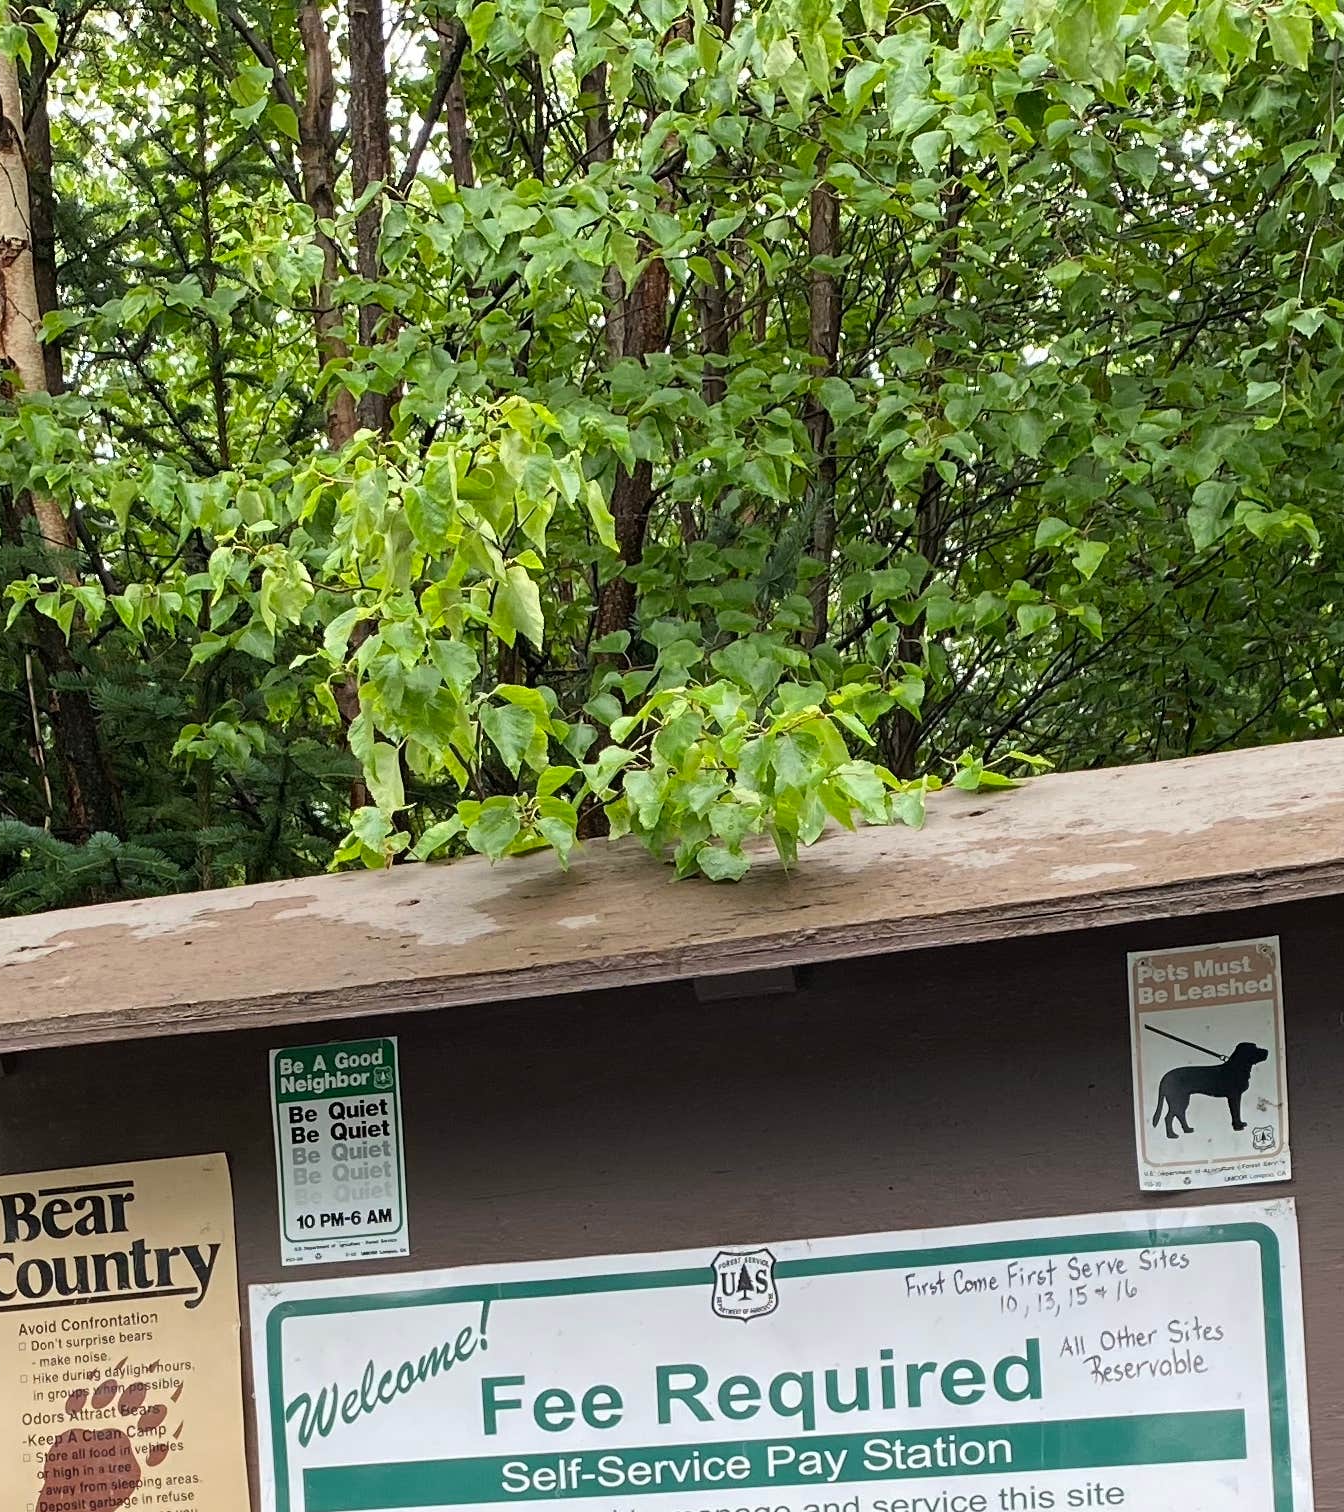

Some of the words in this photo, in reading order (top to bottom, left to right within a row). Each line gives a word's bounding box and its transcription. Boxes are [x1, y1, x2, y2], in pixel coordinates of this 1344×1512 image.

[1138, 964, 1189, 984] Pets
[1193, 955, 1252, 978] Must
[1138, 986, 1169, 1005] Be
[1173, 973, 1274, 1000] Leashed
[279, 1058, 304, 1075] Be
[313, 1055, 326, 1072] A
[334, 1048, 384, 1069] Good
[280, 1071, 371, 1094] Neighbor
[288, 1105, 317, 1124] Be
[328, 1099, 388, 1120] Quiet
[291, 1126, 320, 1144] Be
[330, 1120, 390, 1141] Quiet
[292, 1147, 321, 1165] Be
[331, 1140, 392, 1161] Quiet
[293, 1168, 322, 1185] Be
[332, 1161, 392, 1182] Quiet
[0, 1191, 134, 1243] Bear
[296, 1215, 315, 1229] 10
[366, 1208, 393, 1224] AM
[906, 1272, 946, 1297] First
[954, 1269, 999, 1294] Come
[1007, 1259, 1057, 1288] First
[1068, 1257, 1127, 1281] Serve
[1139, 1250, 1190, 1270] Sites
[19, 1322, 56, 1336] Avoid
[61, 1312, 158, 1332] Confrontation
[1060, 1336, 1085, 1357] All
[1100, 1326, 1156, 1350] Other
[1167, 1316, 1223, 1343] Sites
[31, 1337, 62, 1352] Don't
[66, 1334, 115, 1349] surprise
[119, 1330, 153, 1342] bears
[39, 1355, 71, 1367] make
[285, 1300, 492, 1448] Welcome!
[1083, 1348, 1208, 1385] Reservable
[480, 1375, 624, 1435] Fee
[655, 1338, 1043, 1432] Required
[22, 1412, 64, 1427] Odors
[70, 1408, 116, 1422] Attract
[121, 1403, 160, 1417] Bears
[500, 1451, 751, 1494] Self-Service
[766, 1444, 849, 1483] Pay
[862, 1435, 1013, 1472] Station
[998, 1485, 1055, 1511] this
[1067, 1481, 1125, 1507] site
